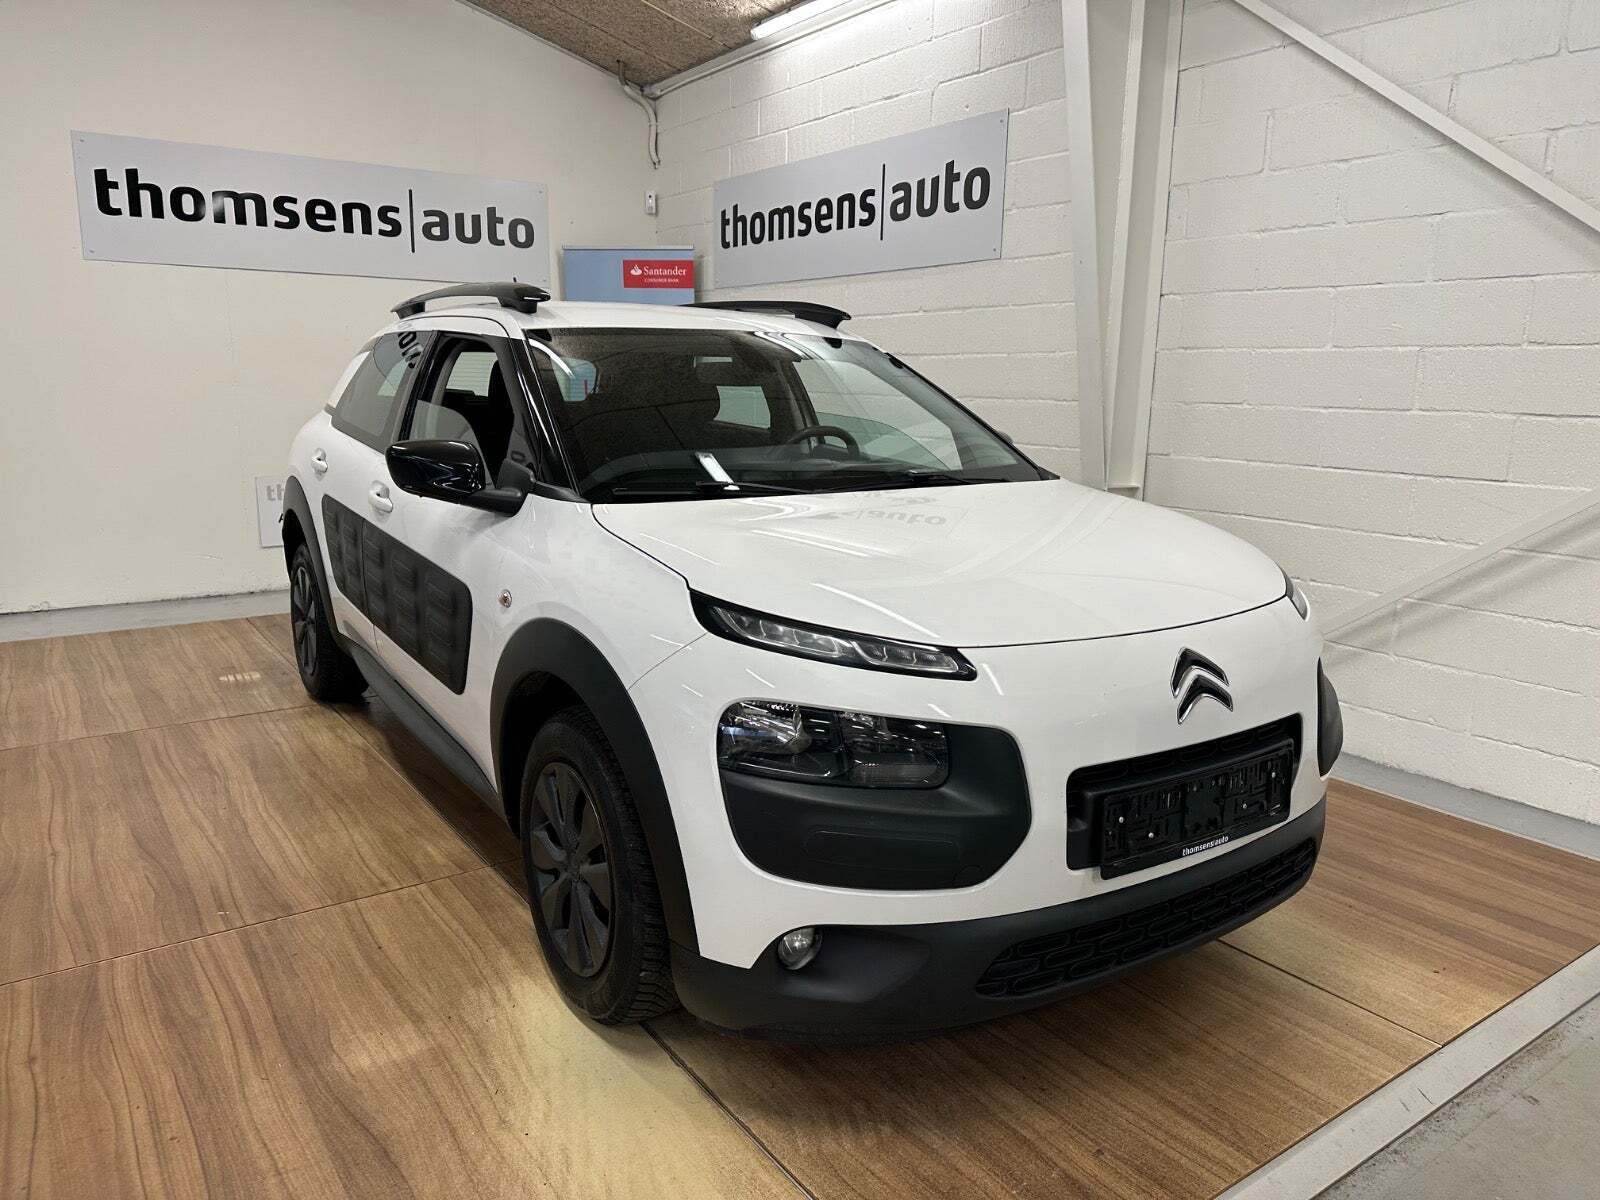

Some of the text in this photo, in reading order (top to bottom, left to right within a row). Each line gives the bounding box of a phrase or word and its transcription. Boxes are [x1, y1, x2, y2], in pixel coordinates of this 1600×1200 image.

[93, 168, 535, 249] thomsens auto
[720, 160, 991, 249] thomsens auto
[643, 265, 687, 276] Santander
